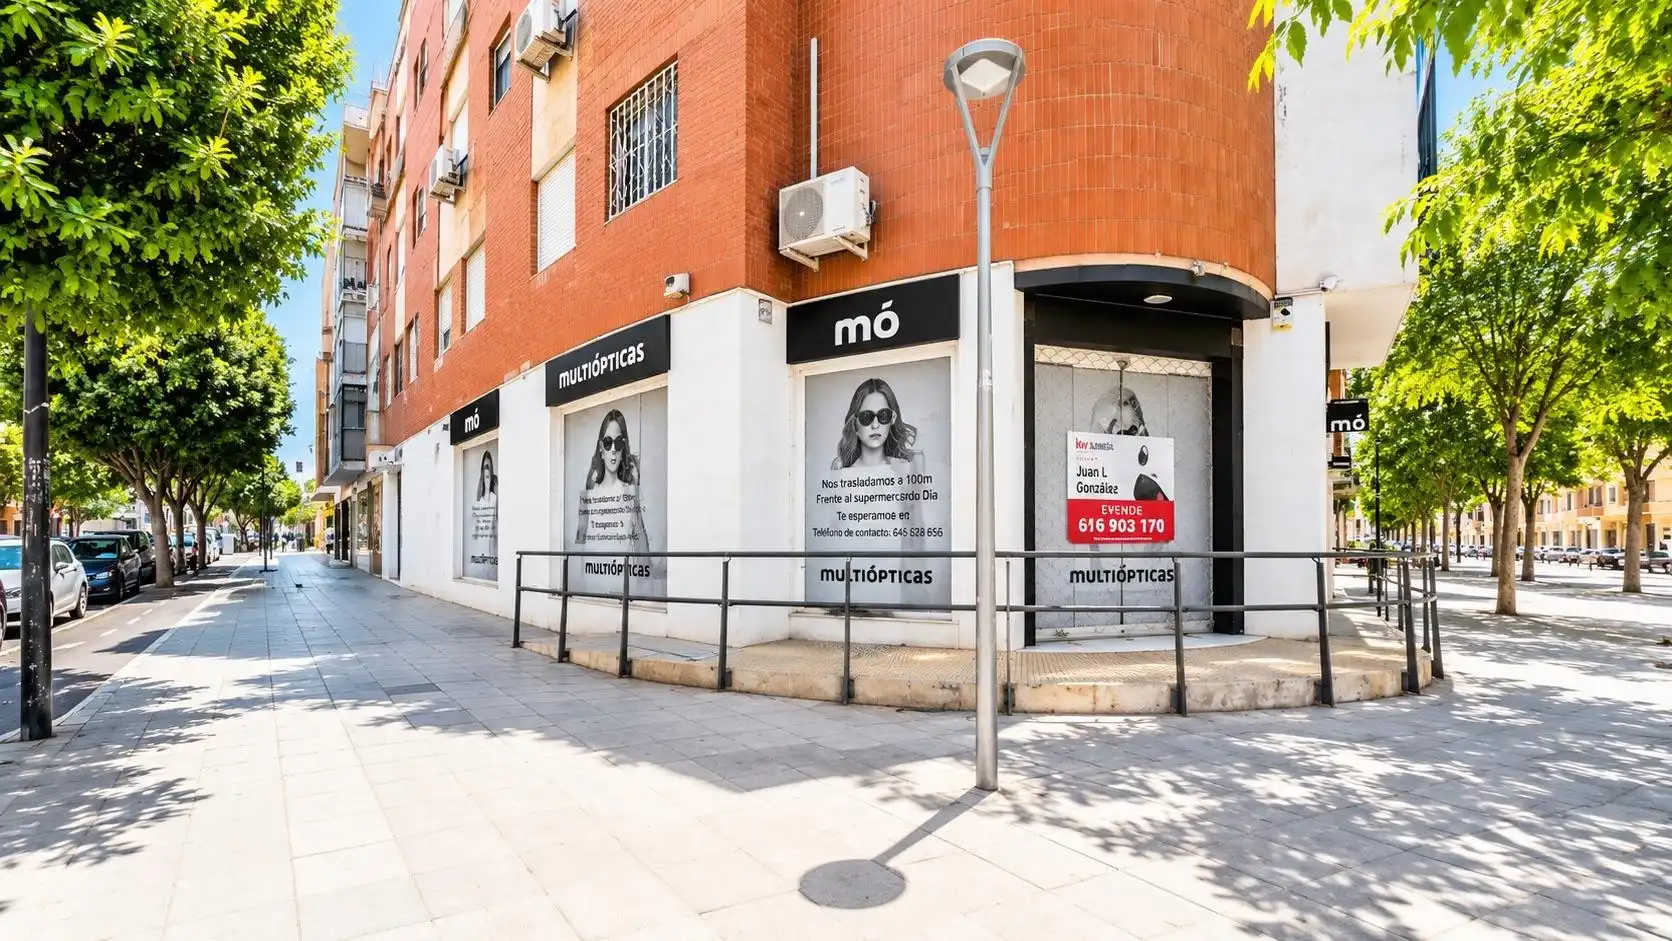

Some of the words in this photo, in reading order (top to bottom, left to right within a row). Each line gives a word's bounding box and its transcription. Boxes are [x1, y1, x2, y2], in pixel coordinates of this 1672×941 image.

[835, 300, 900, 346] mó
[464, 407, 480, 434] mó
[1330, 413, 1365, 431] mó
[1076, 465, 1099, 478] Juan
[821, 479, 838, 489] Nos
[840, 476, 895, 488] trasladamos
[897, 477, 903, 486] a
[906, 474, 933, 485] 100m
[816, 494, 842, 504] Frente
[844, 493, 852, 503] al
[922, 489, 939, 501] Dia
[837, 511, 847, 521] Te
[844, 527, 854, 537] de
[855, 528, 891, 537] contacto:
[1078, 517, 1105, 533] 616
[1109, 518, 1136, 533] 903
[1140, 518, 1165, 533] 170
